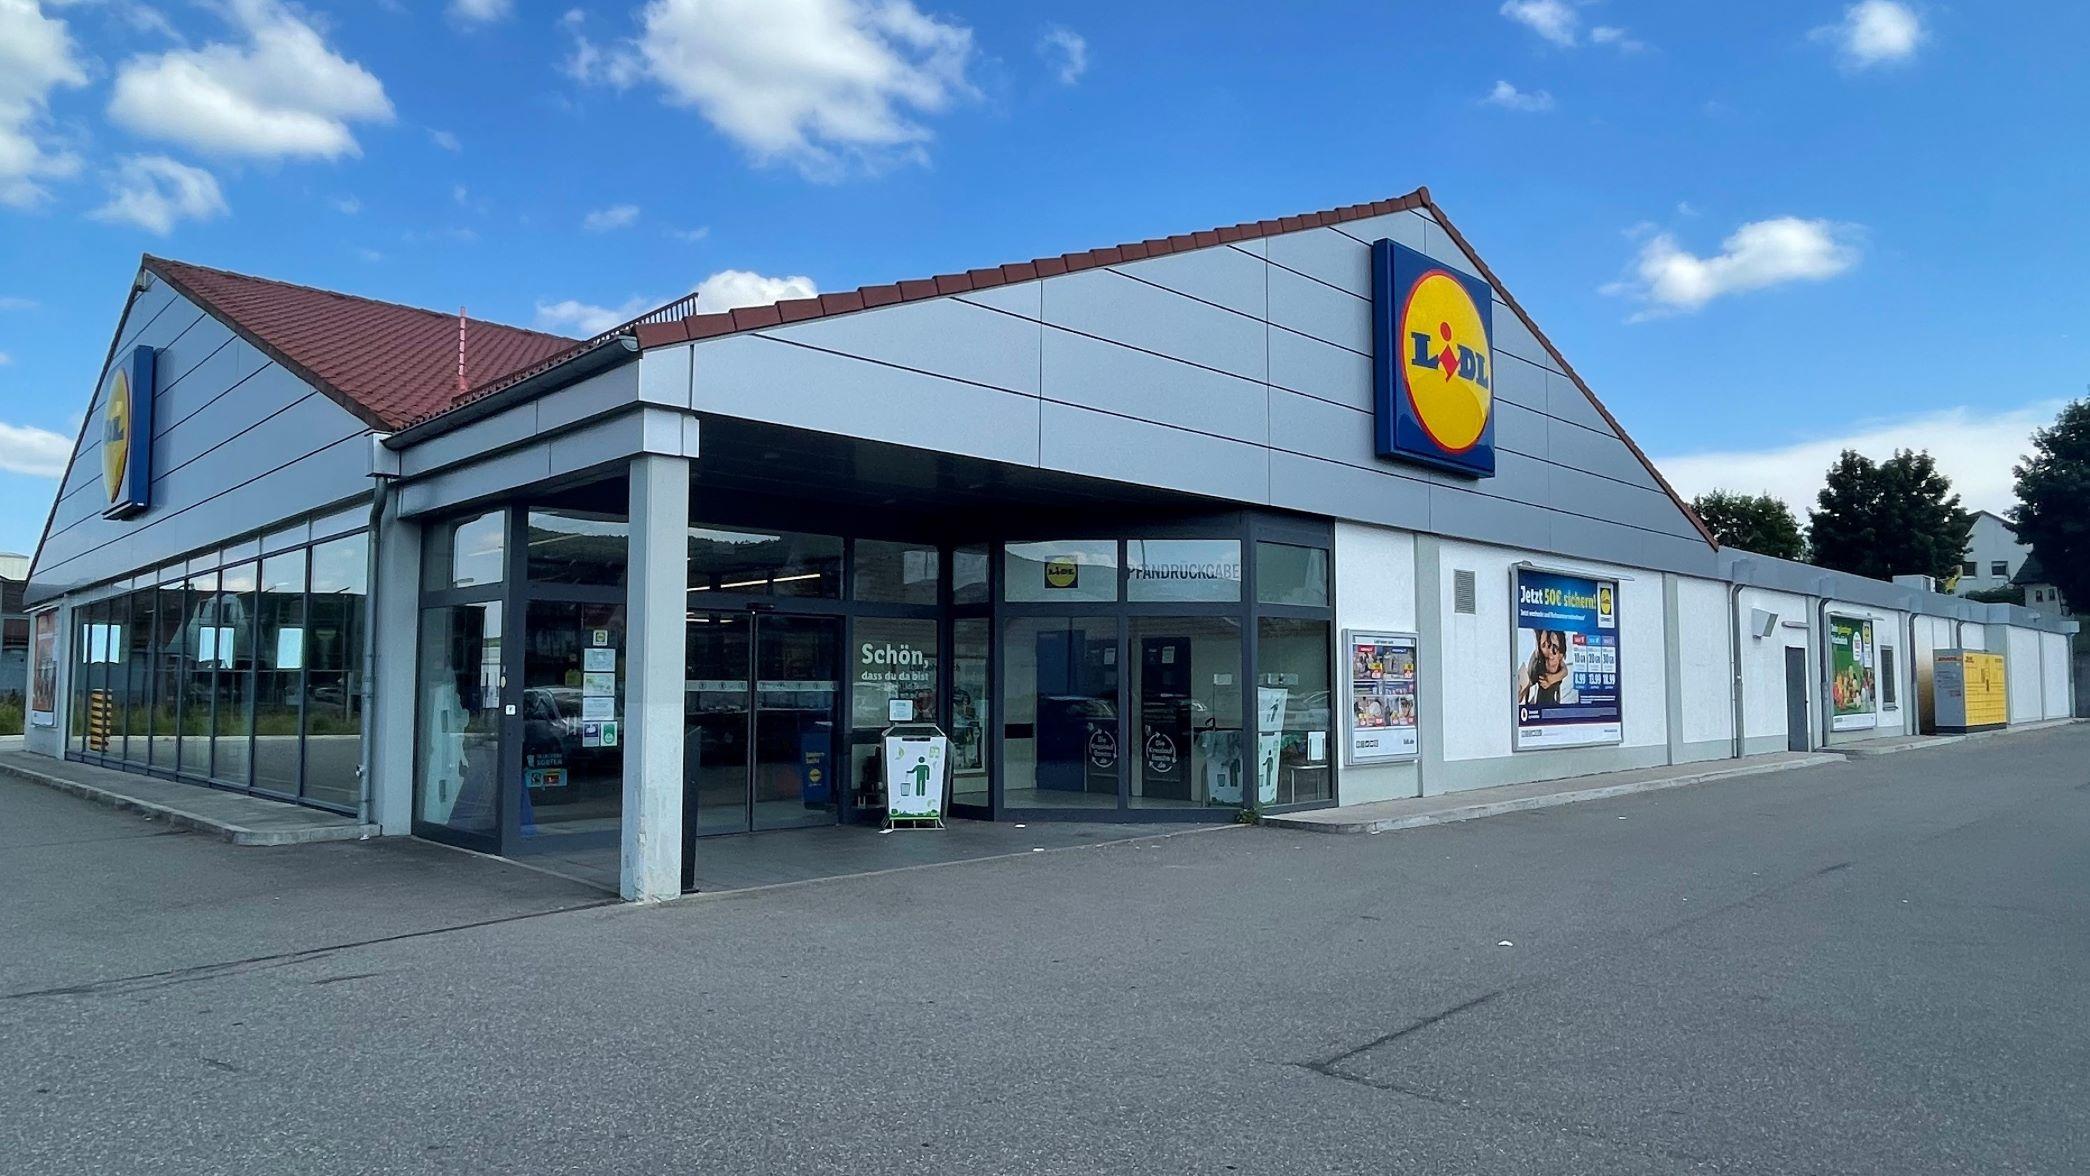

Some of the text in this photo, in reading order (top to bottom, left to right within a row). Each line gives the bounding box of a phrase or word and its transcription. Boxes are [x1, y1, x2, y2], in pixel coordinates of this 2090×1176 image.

[1128, 560, 1239, 580] PFANDRÜCKGABE
[1520, 586, 1597, 609] Jetzt 50€ sichern!
[861, 643, 929, 668] Schön,
[861, 671, 929, 681] dass du da bist
